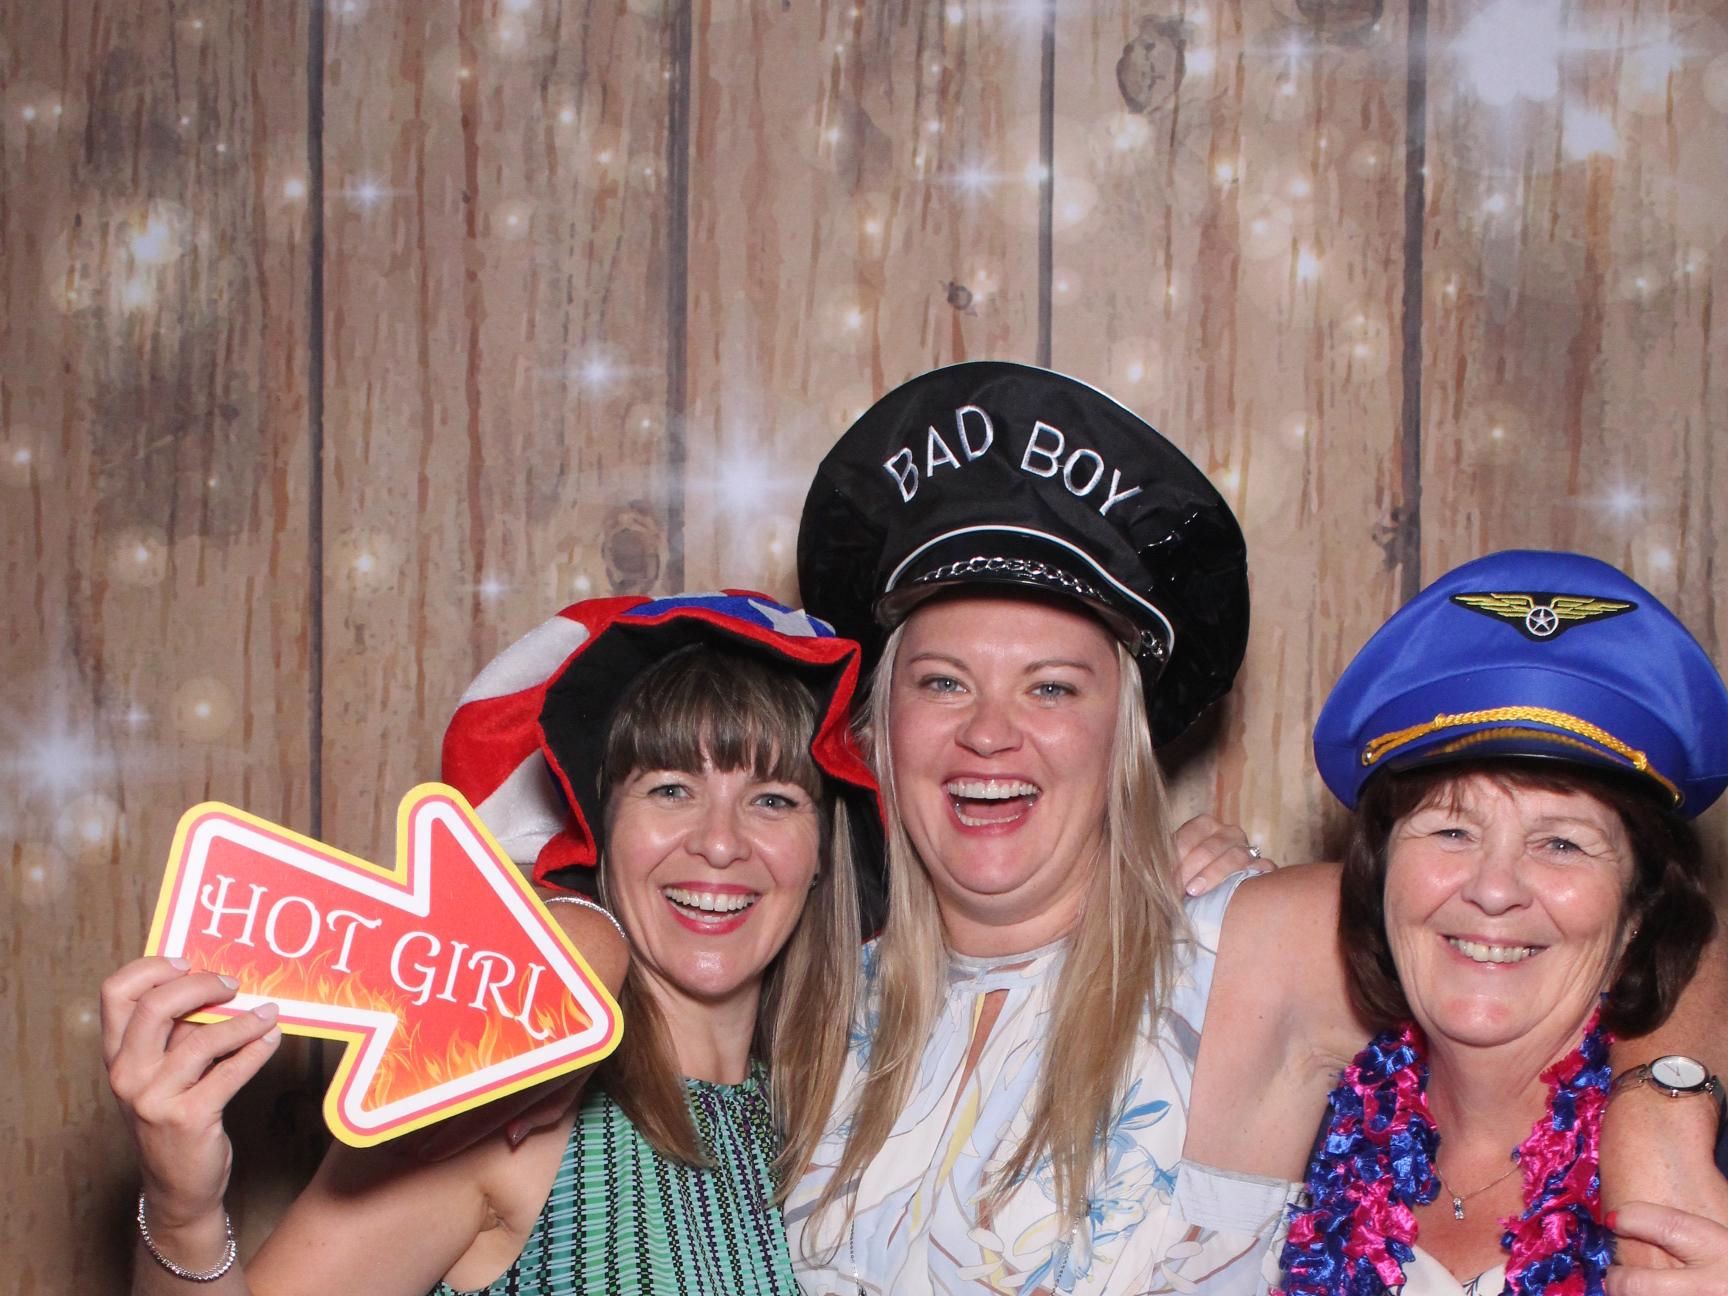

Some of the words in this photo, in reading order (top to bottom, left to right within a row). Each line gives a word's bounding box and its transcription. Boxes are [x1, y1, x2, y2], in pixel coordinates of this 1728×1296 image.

[883, 404, 995, 503] BAD
[1020, 419, 1143, 516] BOY
[201, 874, 383, 975] HOT
[390, 930, 550, 1041] GIRL
